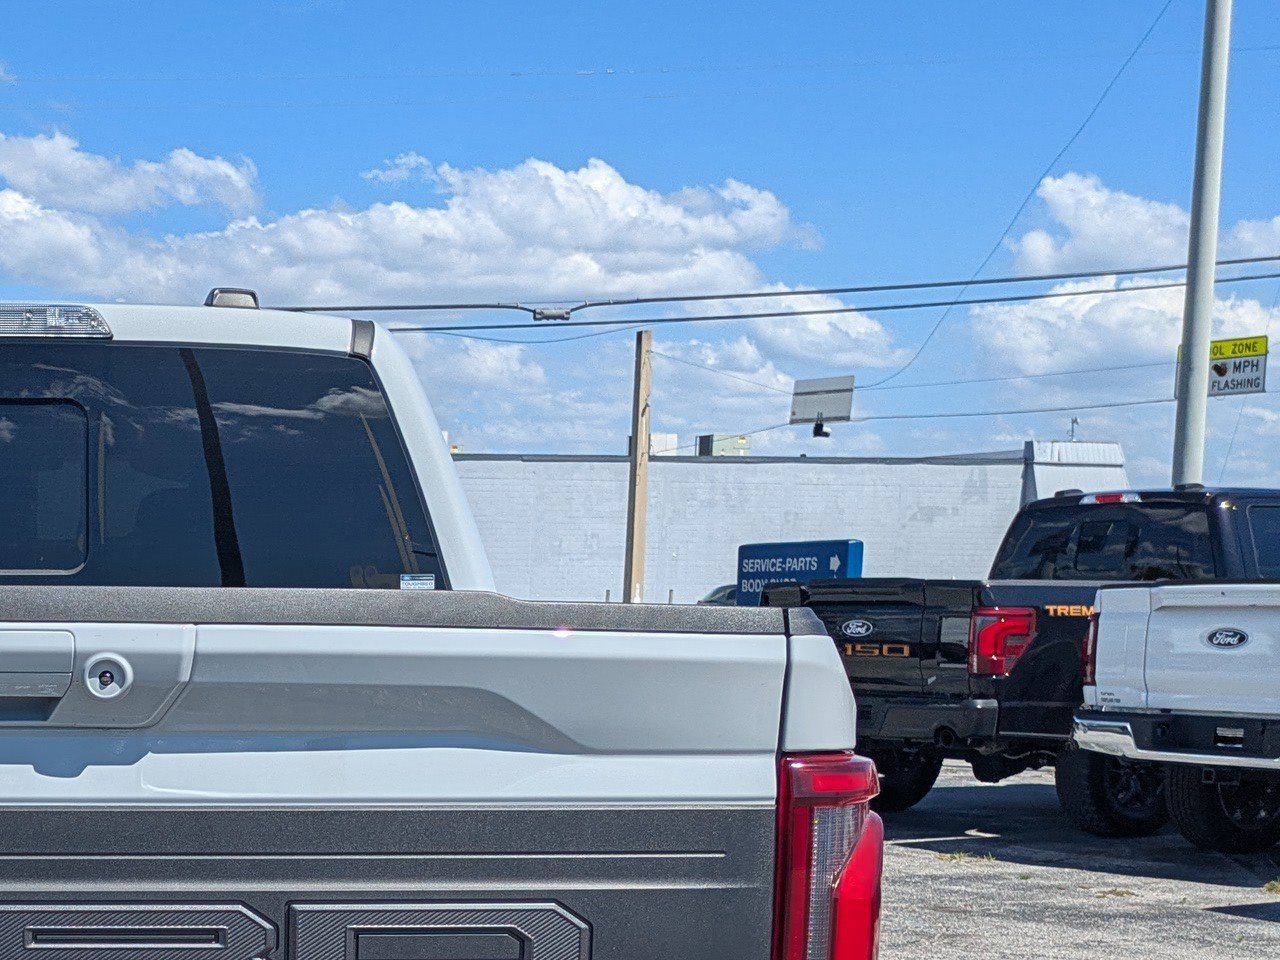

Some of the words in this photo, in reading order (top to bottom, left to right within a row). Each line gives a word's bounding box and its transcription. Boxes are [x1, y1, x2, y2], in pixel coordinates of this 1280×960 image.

[1231, 342, 1258, 354] ZONE
[1233, 360, 1259, 374] MPH
[1211, 377, 1261, 391] FLASHING
[742, 557, 818, 573] SERVICE-PARTS
